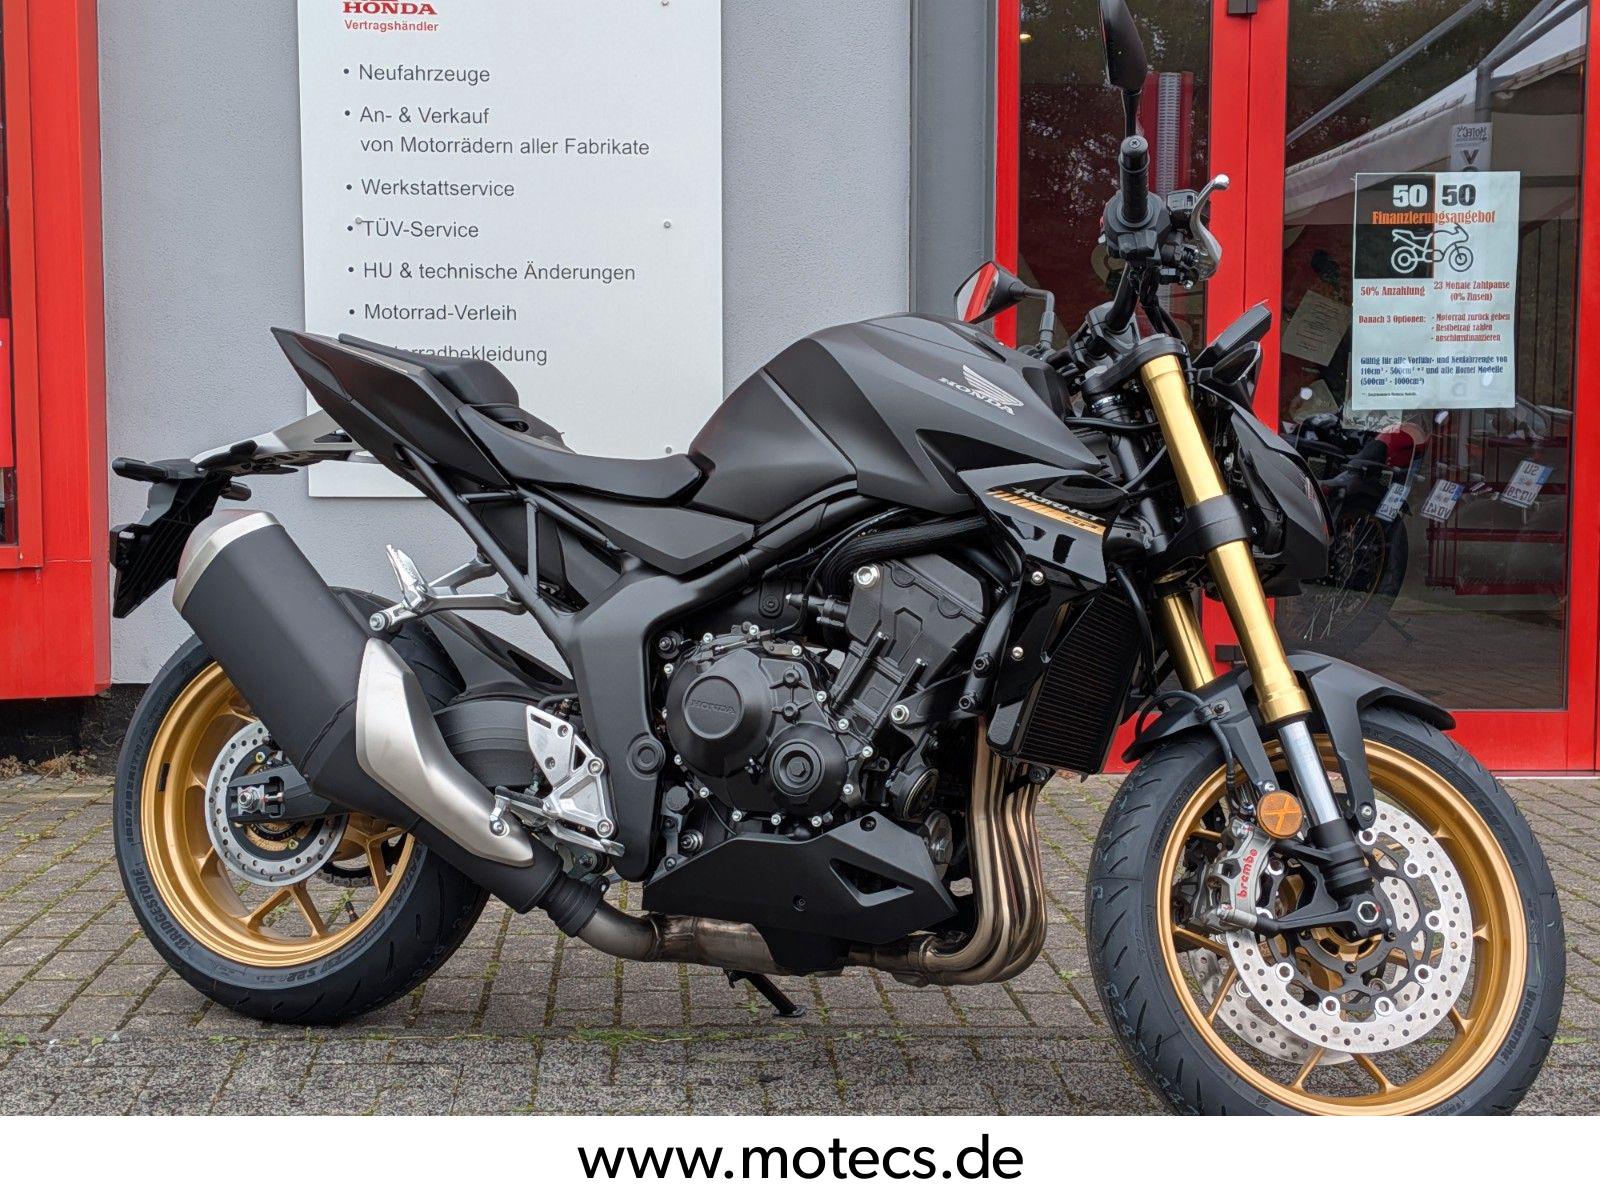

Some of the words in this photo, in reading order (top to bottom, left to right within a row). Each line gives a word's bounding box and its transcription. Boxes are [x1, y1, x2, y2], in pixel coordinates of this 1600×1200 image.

[342, 1, 438, 15] HONDA
[344, 19, 440, 33] Vertragshändler
[359, 64, 491, 87] Neufahrzeuge
[359, 106, 392, 123] An-
[398, 106, 412, 124] &
[417, 106, 491, 124] Verkauf
[360, 138, 394, 153] von
[400, 136, 514, 154] Motorrädern
[520, 138, 560, 154] aller
[565, 138, 651, 155] Fabrikate
[361, 179, 515, 197] Werkstattservice
[1393, 184, 1428, 208] 50
[1442, 184, 1476, 207] 50
[1372, 210, 1496, 225] Finanzierungsangebot
[363, 218, 479, 238] TÜV-Service
[363, 262, 393, 279] HU
[399, 262, 413, 280] &
[418, 262, 519, 280] technische
[523, 260, 636, 284] Änderungen
[1360, 286, 1380, 297] 50%
[1382, 285, 1426, 297] Anzahlung
[1434, 281, 1444, 290] 23
[1446, 281, 1470, 290] Monate
[1472, 280, 1511, 291] Zahlpause
[1467, 292, 1494, 302] Zinsen)
[364, 303, 518, 321] Motorrad-Verleih
[1358, 315, 1385, 324] Danach
[1393, 315, 1427, 324] Optionen:
[936, 376, 1017, 416] HONDA
[688, 698, 738, 716] HONDA
[1236, 848, 1258, 898] brembo
[131, 864, 192, 953] BRIDGESTONE
